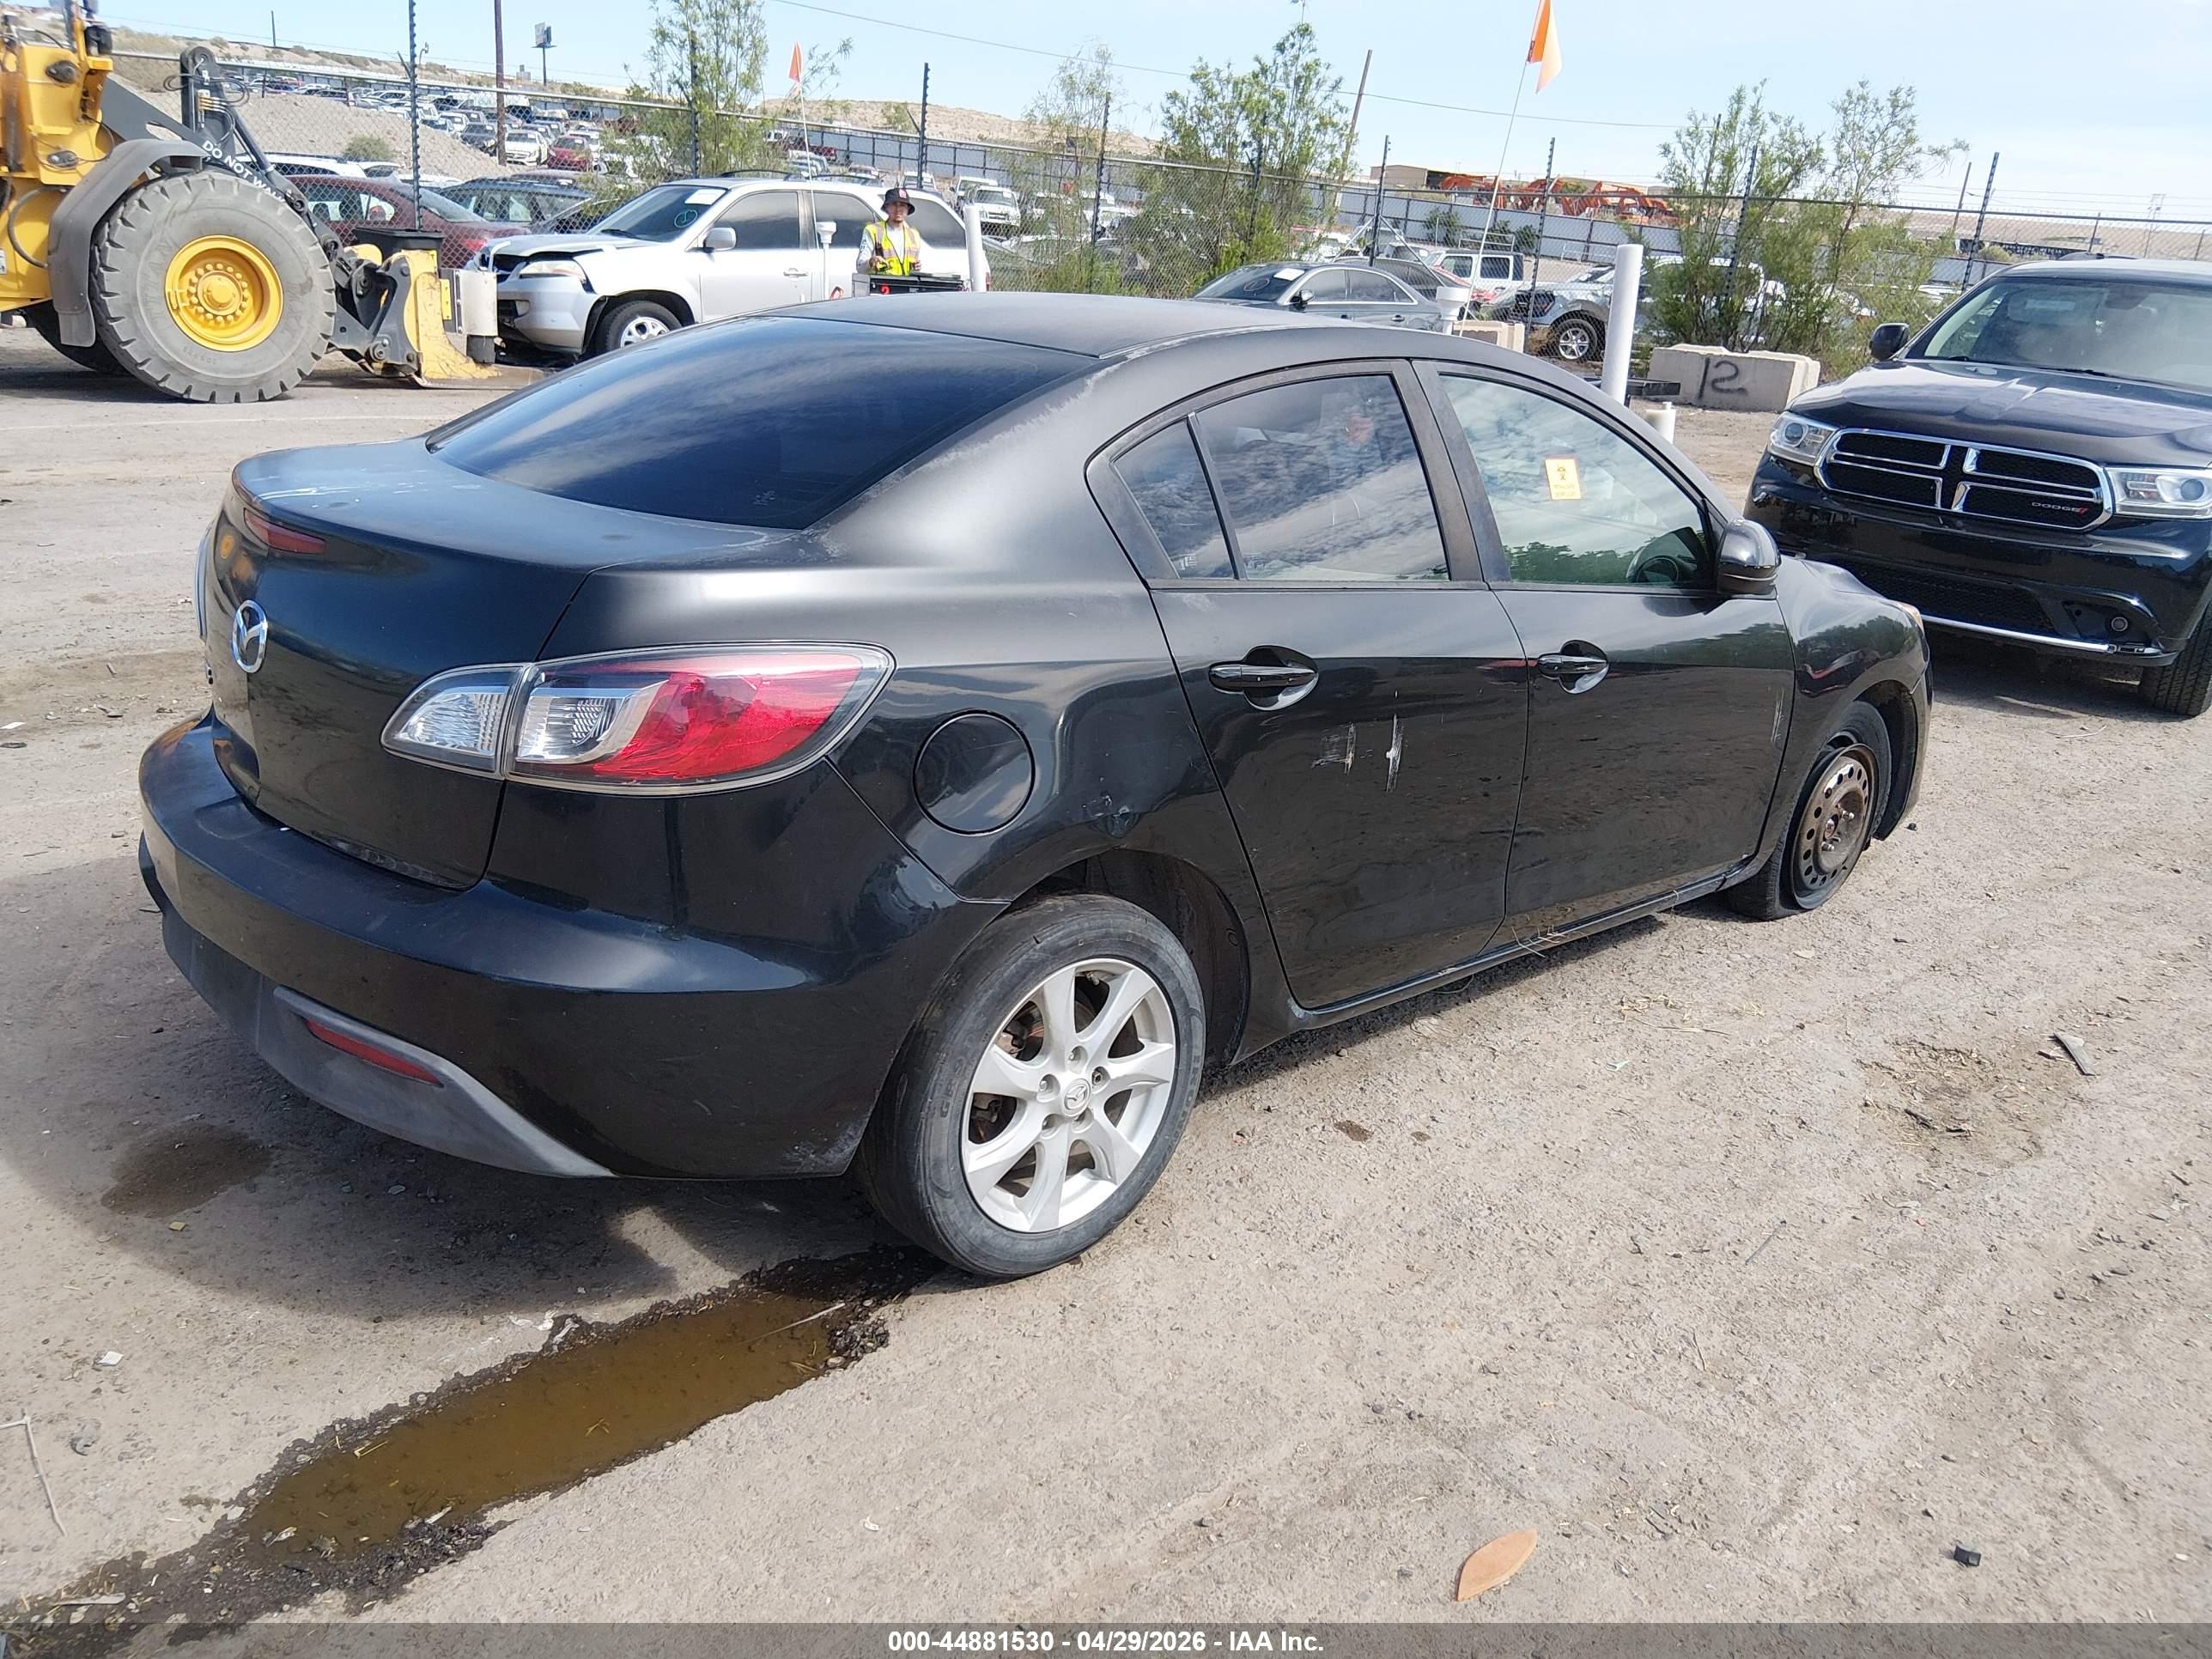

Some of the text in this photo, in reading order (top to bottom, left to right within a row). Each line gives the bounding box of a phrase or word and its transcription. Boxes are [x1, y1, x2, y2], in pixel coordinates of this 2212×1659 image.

[203, 140, 286, 203] DO NOT WA
[1698, 357, 1748, 399] 12
[2032, 502, 2081, 512] DODGE
